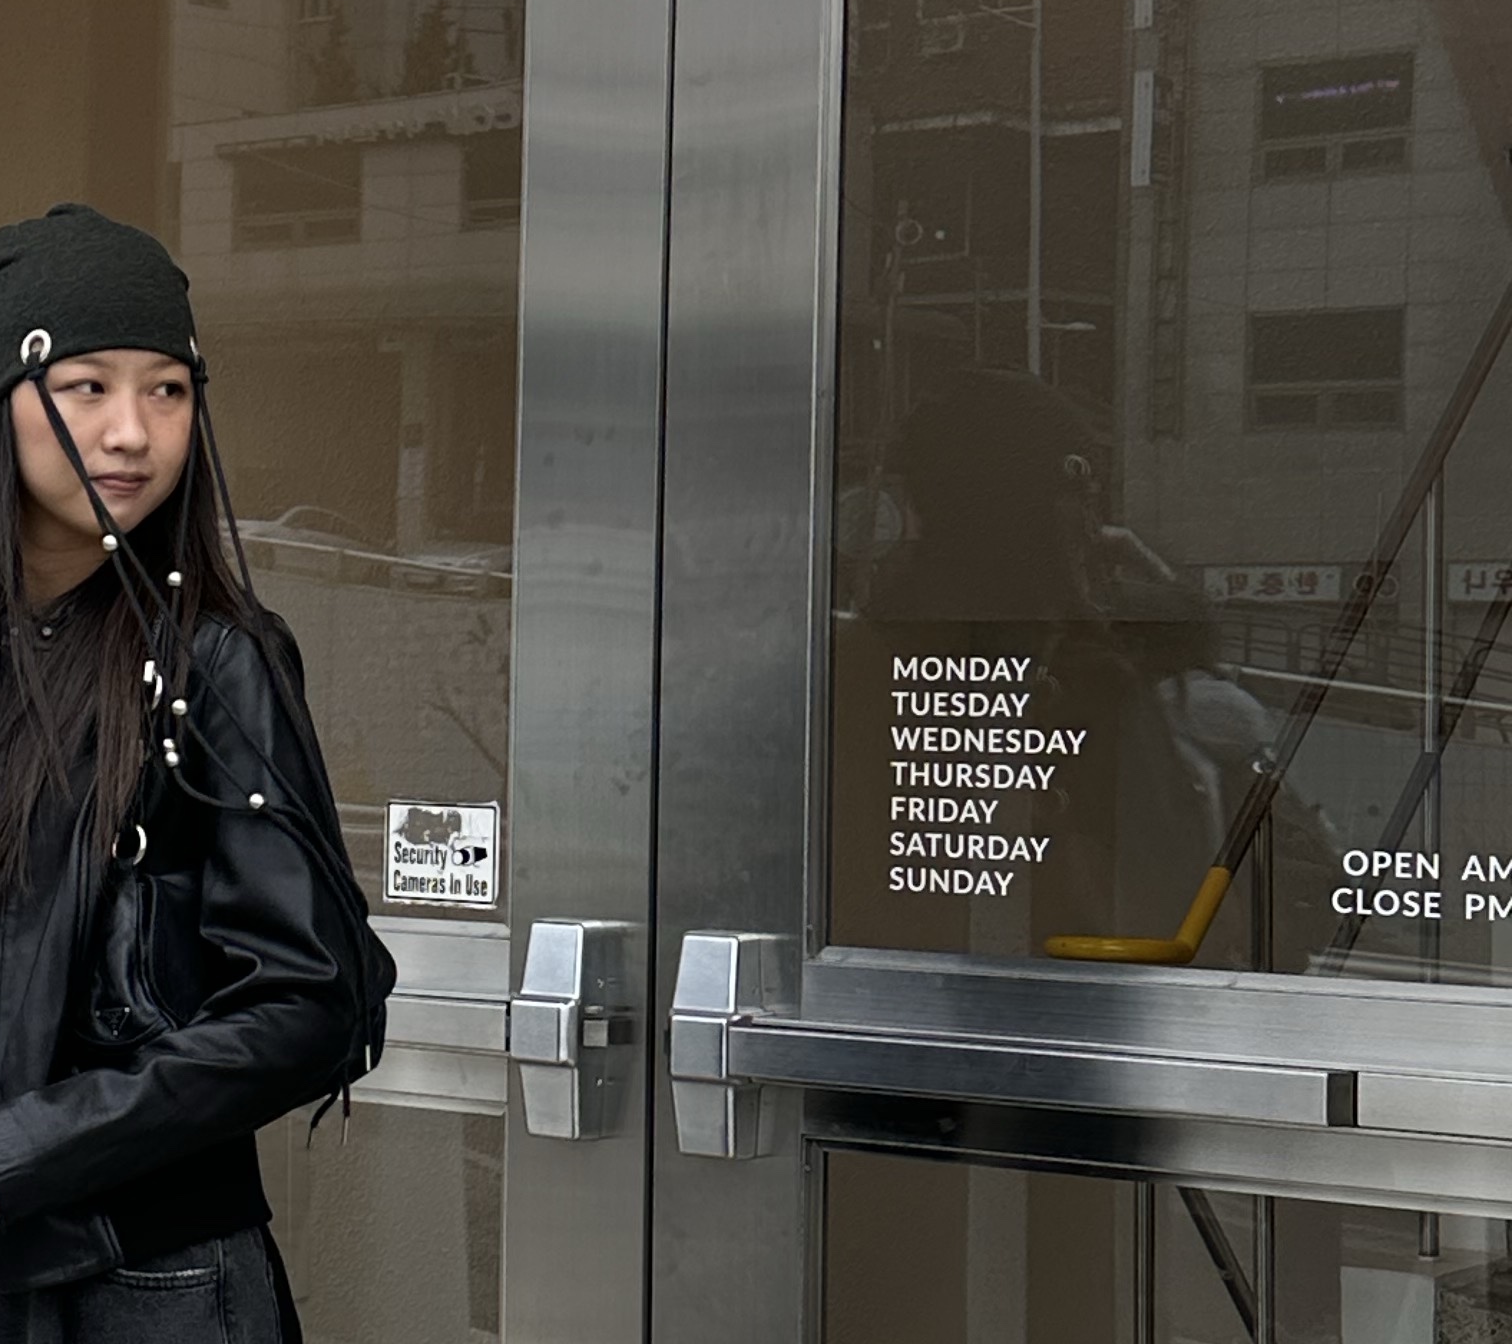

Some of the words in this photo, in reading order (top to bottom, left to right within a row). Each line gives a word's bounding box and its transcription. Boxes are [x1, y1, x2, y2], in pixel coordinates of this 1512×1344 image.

[892, 656, 1032, 682] MONDAY
[891, 691, 1031, 718] TUESDAY
[890, 726, 1087, 755] WEDNESDAY
[889, 761, 1056, 790] THURSDAY
[889, 796, 999, 824] FRIDAY
[393, 840, 448, 871] Security
[889, 831, 1050, 863] SATURDAY
[1342, 849, 1440, 880] OPEN
[1460, 854, 1512, 883] AM
[393, 869, 446, 894] Cameras
[465, 873, 488, 897] Use
[888, 866, 1014, 897] SUNDAY
[1331, 887, 1442, 919] CLOSE
[1465, 893, 1512, 921] PM
